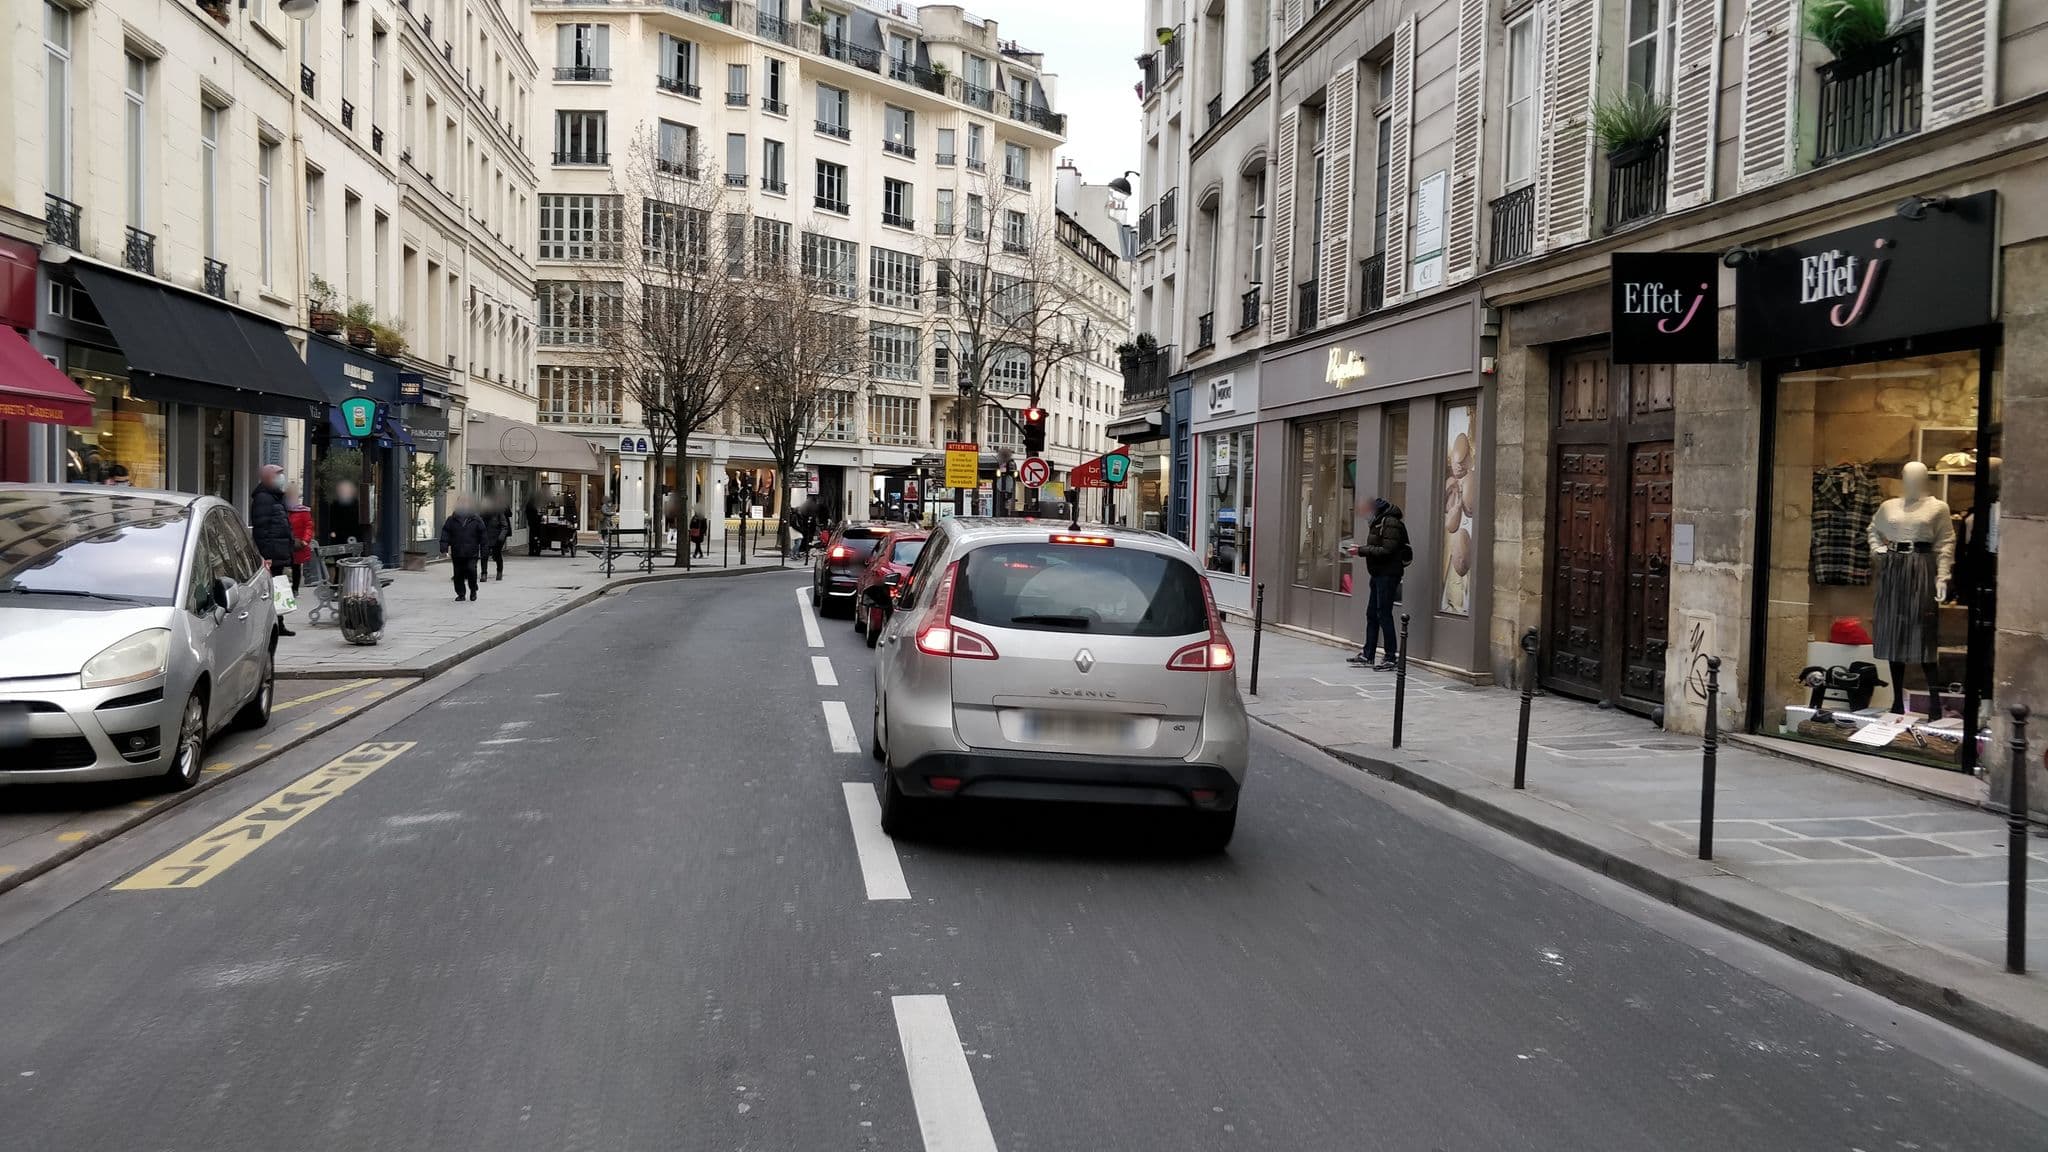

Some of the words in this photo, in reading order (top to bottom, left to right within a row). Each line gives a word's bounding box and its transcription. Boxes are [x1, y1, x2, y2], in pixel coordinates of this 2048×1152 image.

[1800, 249, 1858, 304] Effet
[1623, 282, 1683, 314] Effet
[1657, 282, 1708, 334] j
